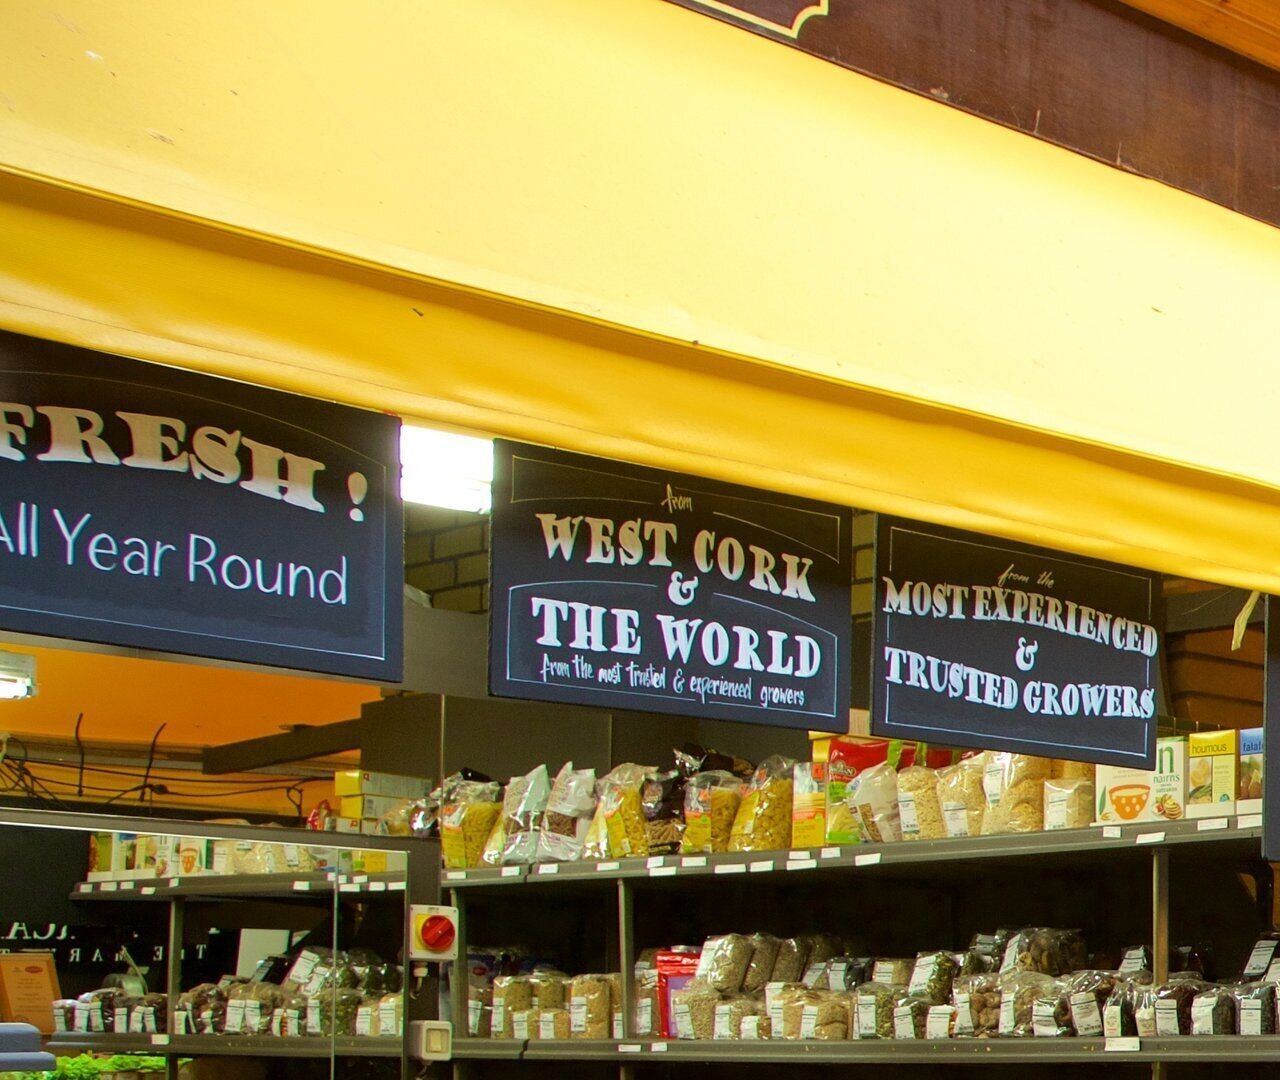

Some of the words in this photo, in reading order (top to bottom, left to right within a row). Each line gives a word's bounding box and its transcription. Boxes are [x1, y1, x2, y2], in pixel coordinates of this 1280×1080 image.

[661, 484, 692, 513] from
[53, 511, 175, 579] Year
[188, 532, 349, 607] Round
[535, 513, 677, 566] WEST
[694, 530, 816, 602] CORK
[998, 564, 1030, 585] from
[1037, 570, 1055, 589] the
[668, 571, 698, 605] &
[531, 597, 641, 655] THE
[656, 613, 821, 678] WORLD
[882, 576, 970, 619] MOST
[972, 584, 1158, 657] EXPERIENCED
[540, 653, 570, 682] from
[571, 654, 594, 679] the
[598, 663, 622, 685] most
[625, 662, 666, 689] trusted
[673, 668, 685, 693] &
[690, 677, 752, 704] experienced
[761, 687, 805, 708] growers
[1015, 636, 1038, 671] &
[884, 646, 1019, 710] TRUSTED
[1023, 680, 1155, 719] GROWERS
[1192, 742, 1227, 754] houmous
